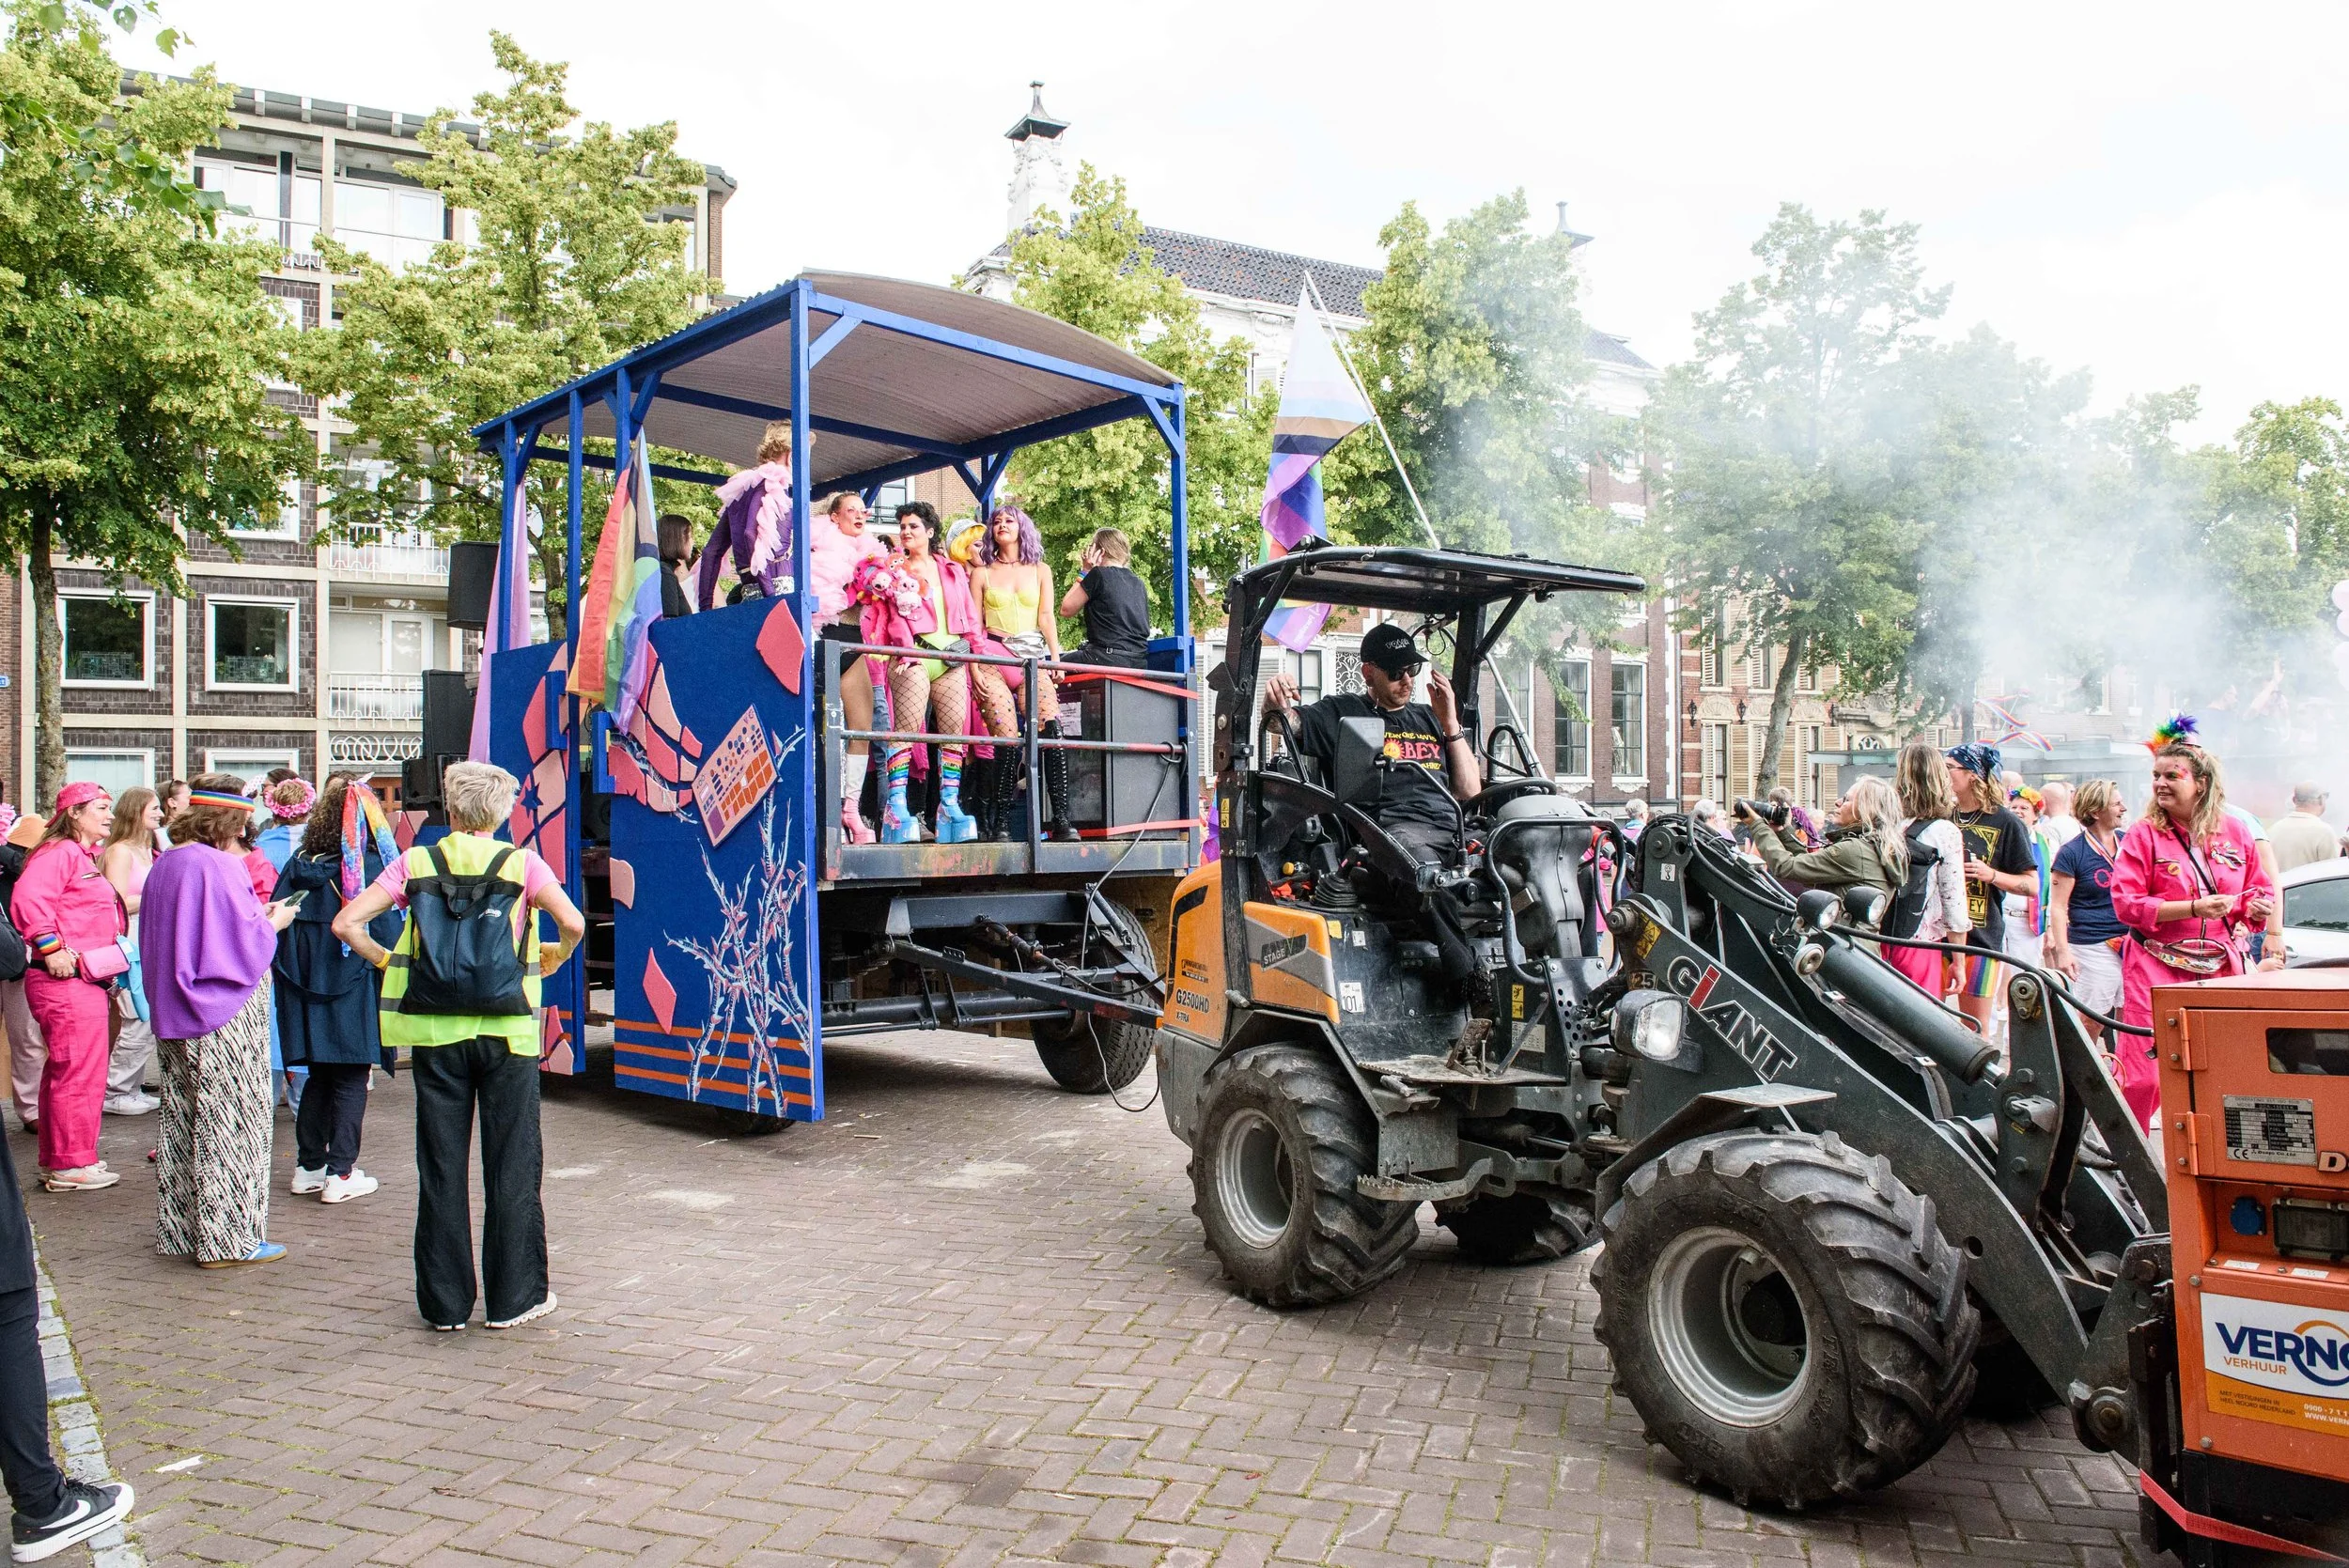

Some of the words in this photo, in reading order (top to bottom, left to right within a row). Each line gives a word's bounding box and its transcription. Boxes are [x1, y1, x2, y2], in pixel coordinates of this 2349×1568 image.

[1263, 948, 1286, 965] STAGE
[1175, 988, 1210, 1014] G2500HD
[1343, 995, 1358, 1012] 101
[2318, 1151, 2349, 1172] D
[2223, 1356, 2287, 1375] VERHUUR
[2233, 1393, 2272, 1404] VESTIGINGEN
[2235, 1400, 2258, 1408] NOORD
[2259, 1404, 2296, 1415] NEDERLAND
[2304, 1403, 2323, 1412] 0900
